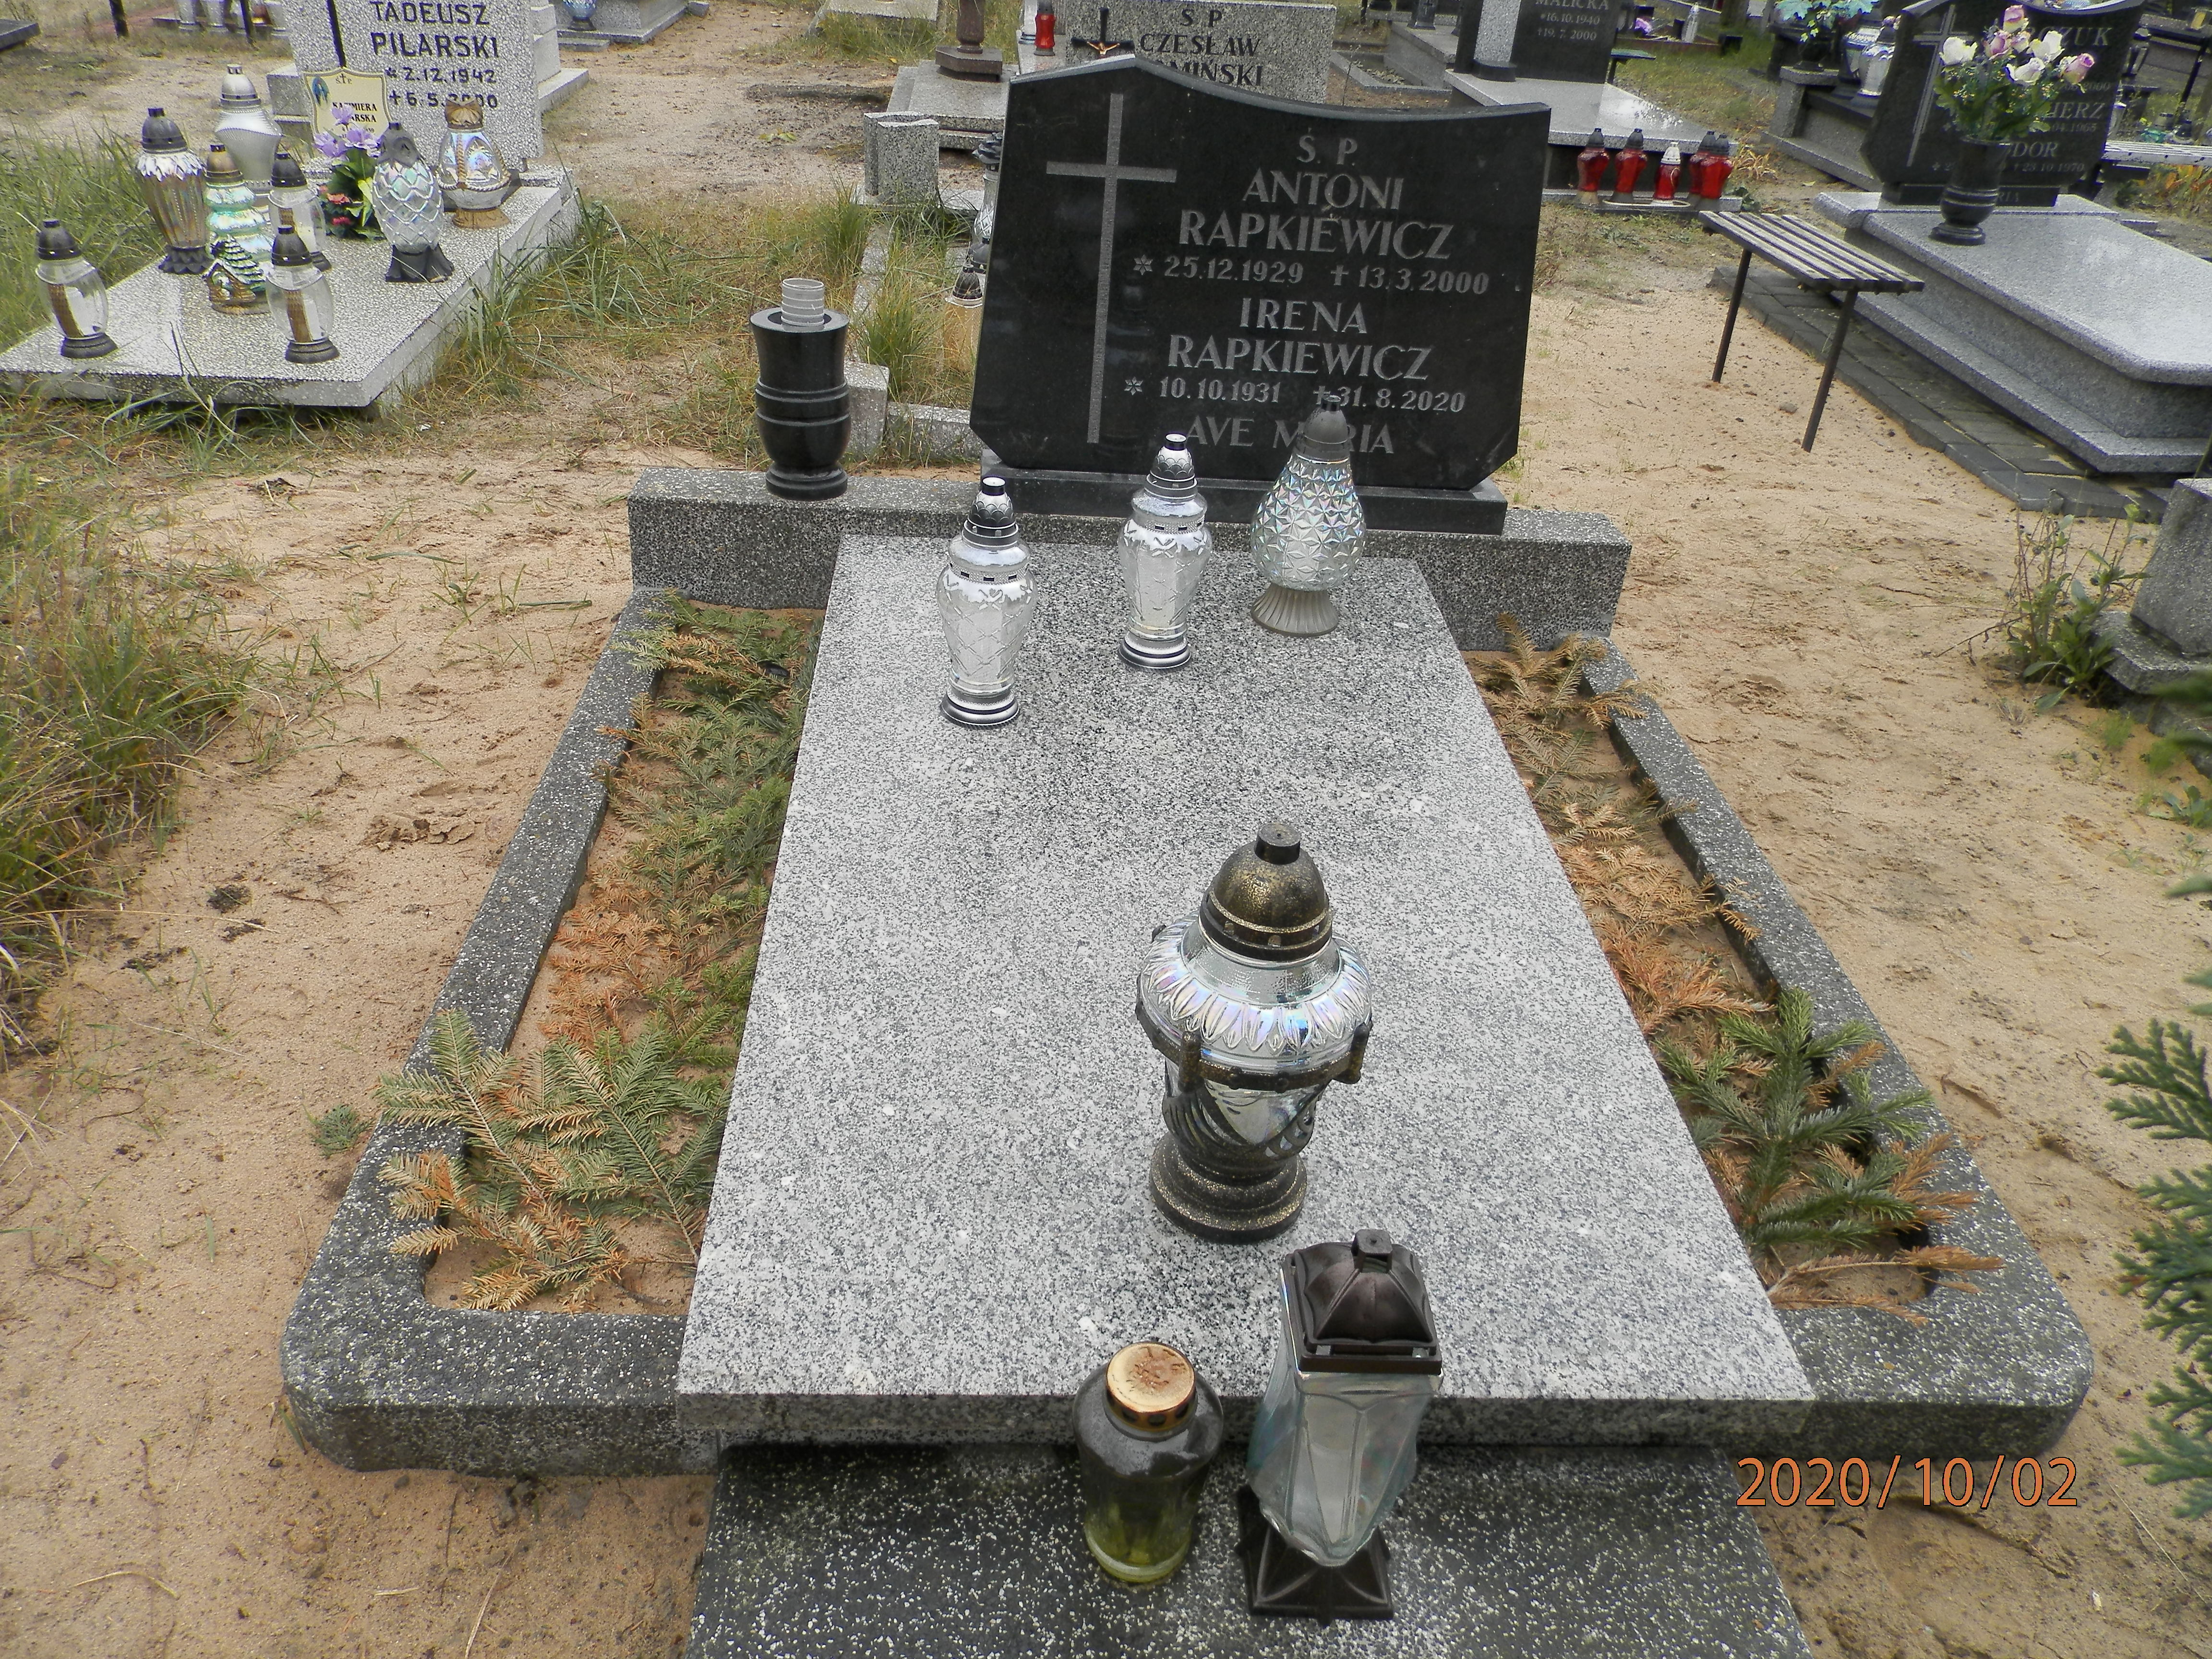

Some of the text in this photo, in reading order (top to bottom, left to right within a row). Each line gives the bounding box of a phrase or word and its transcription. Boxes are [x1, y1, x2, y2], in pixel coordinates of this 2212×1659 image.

[370, 1, 489, 24] TADEUSZ
[1208, 10, 1223, 27] P
[371, 32, 498, 58] PILARSKI
[1140, 34, 1261, 57] CZESŁAW
[403, 67, 496, 84] 2.12.1942
[332, 102, 377, 111] KAMIERA
[1336, 138, 1356, 166] P.
[1242, 168, 1404, 210] ANTONI
[1179, 209, 1454, 260] RAPKIEWICZ
[1164, 255, 1304, 284] 25.12.1929
[1240, 297, 1368, 334] IRENA
[1168, 335, 1433, 381] RAPKIEWICZ
[1160, 376, 1281, 403] 10.10.1931
[1186, 416, 1395, 454] AVE MRIA
